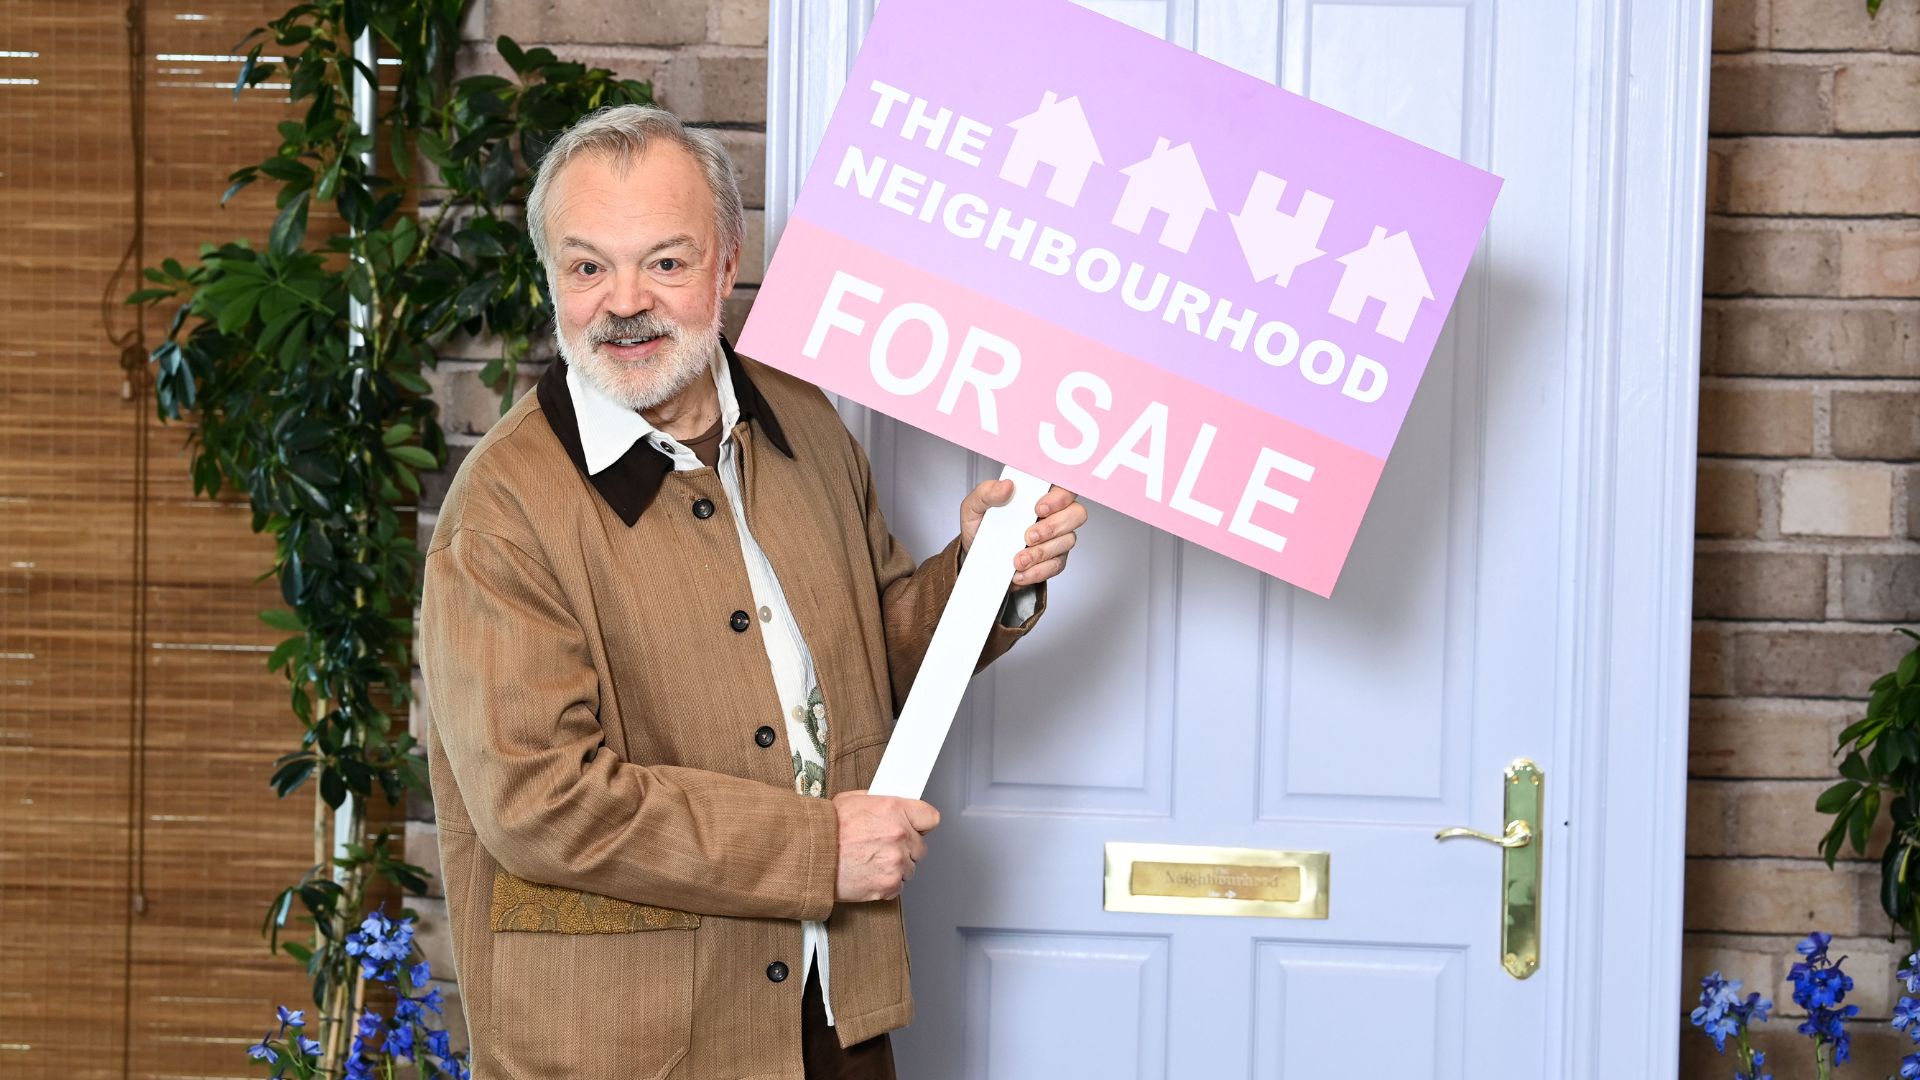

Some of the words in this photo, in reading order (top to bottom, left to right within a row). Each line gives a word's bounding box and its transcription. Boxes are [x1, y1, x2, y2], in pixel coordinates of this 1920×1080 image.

[869, 79, 994, 168] THE
[833, 145, 1389, 403] NEIGHBOURHOOD
[801, 270, 1022, 436] FOR
[1038, 371, 1316, 553] SALE
